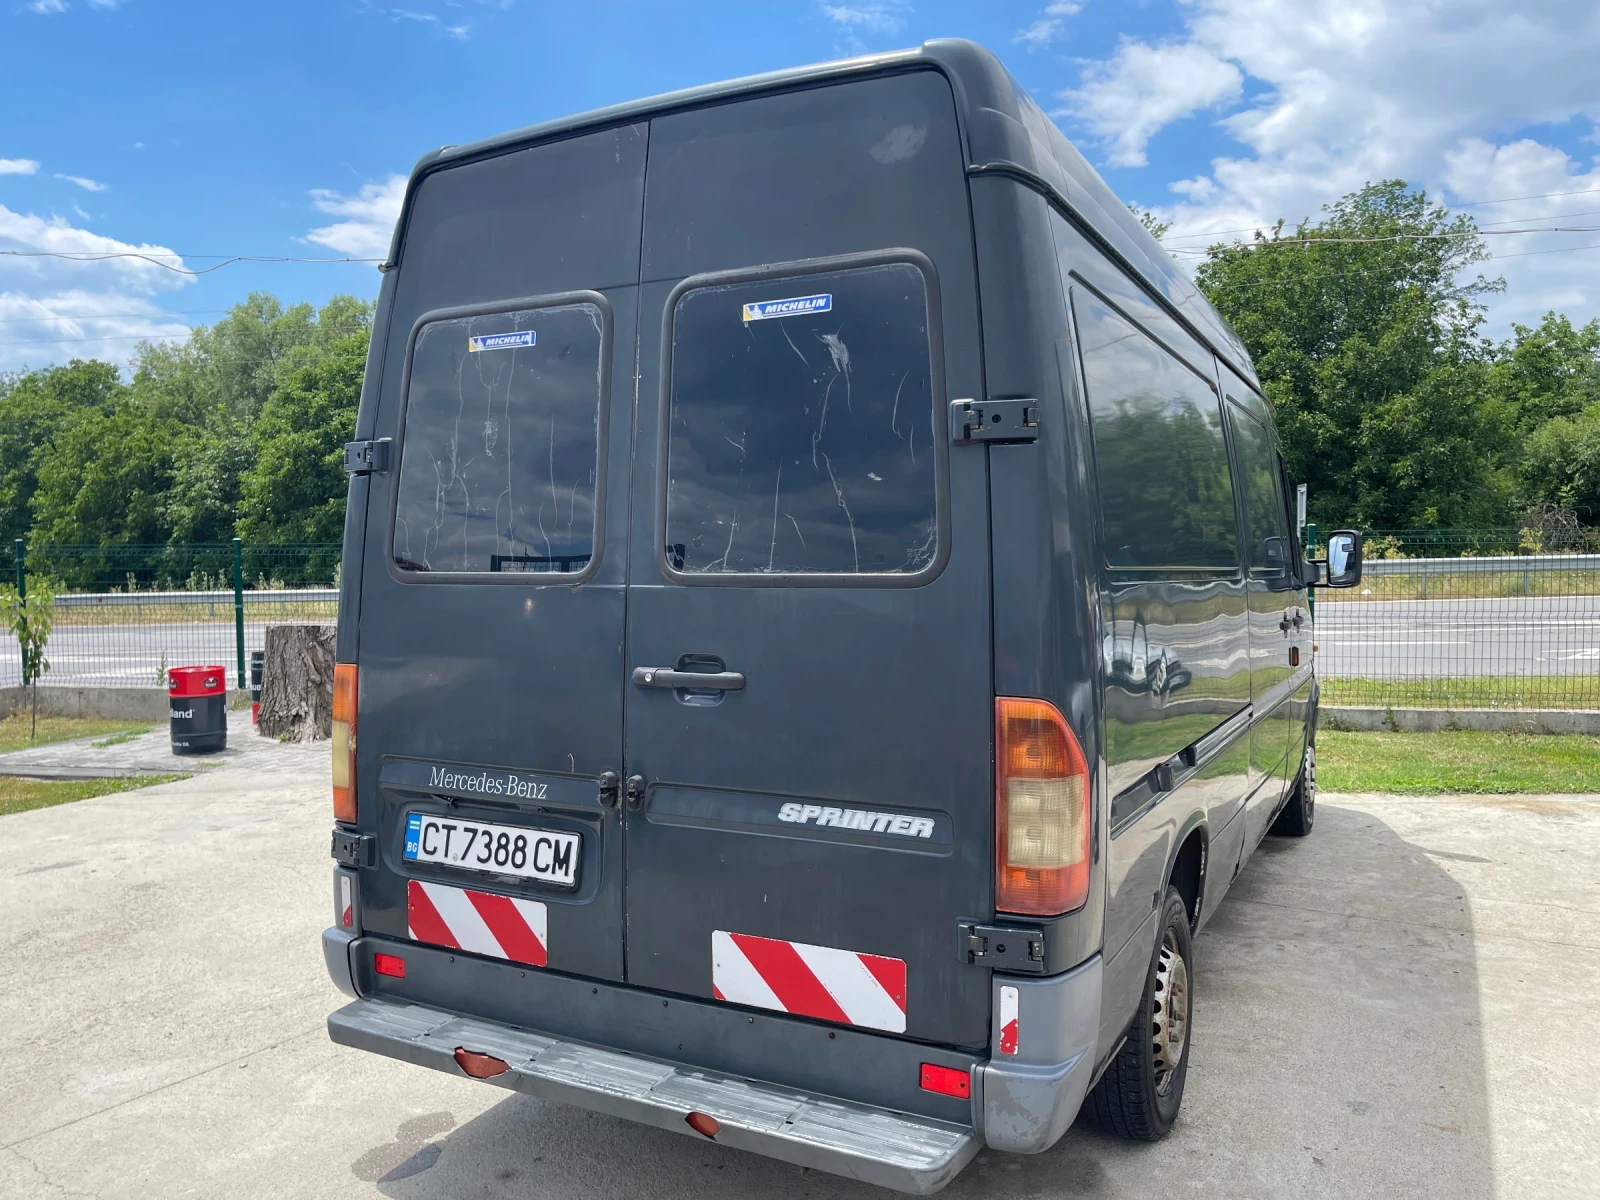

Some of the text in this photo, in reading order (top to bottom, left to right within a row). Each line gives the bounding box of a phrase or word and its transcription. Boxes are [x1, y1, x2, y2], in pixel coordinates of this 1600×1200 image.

[765, 298, 826, 313] MICHELIN
[485, 334, 530, 346] MICHELIN
[428, 766, 548, 800] Mercedes-Benz
[777, 802, 935, 839] SPRINTER
[407, 841, 418, 853] BG
